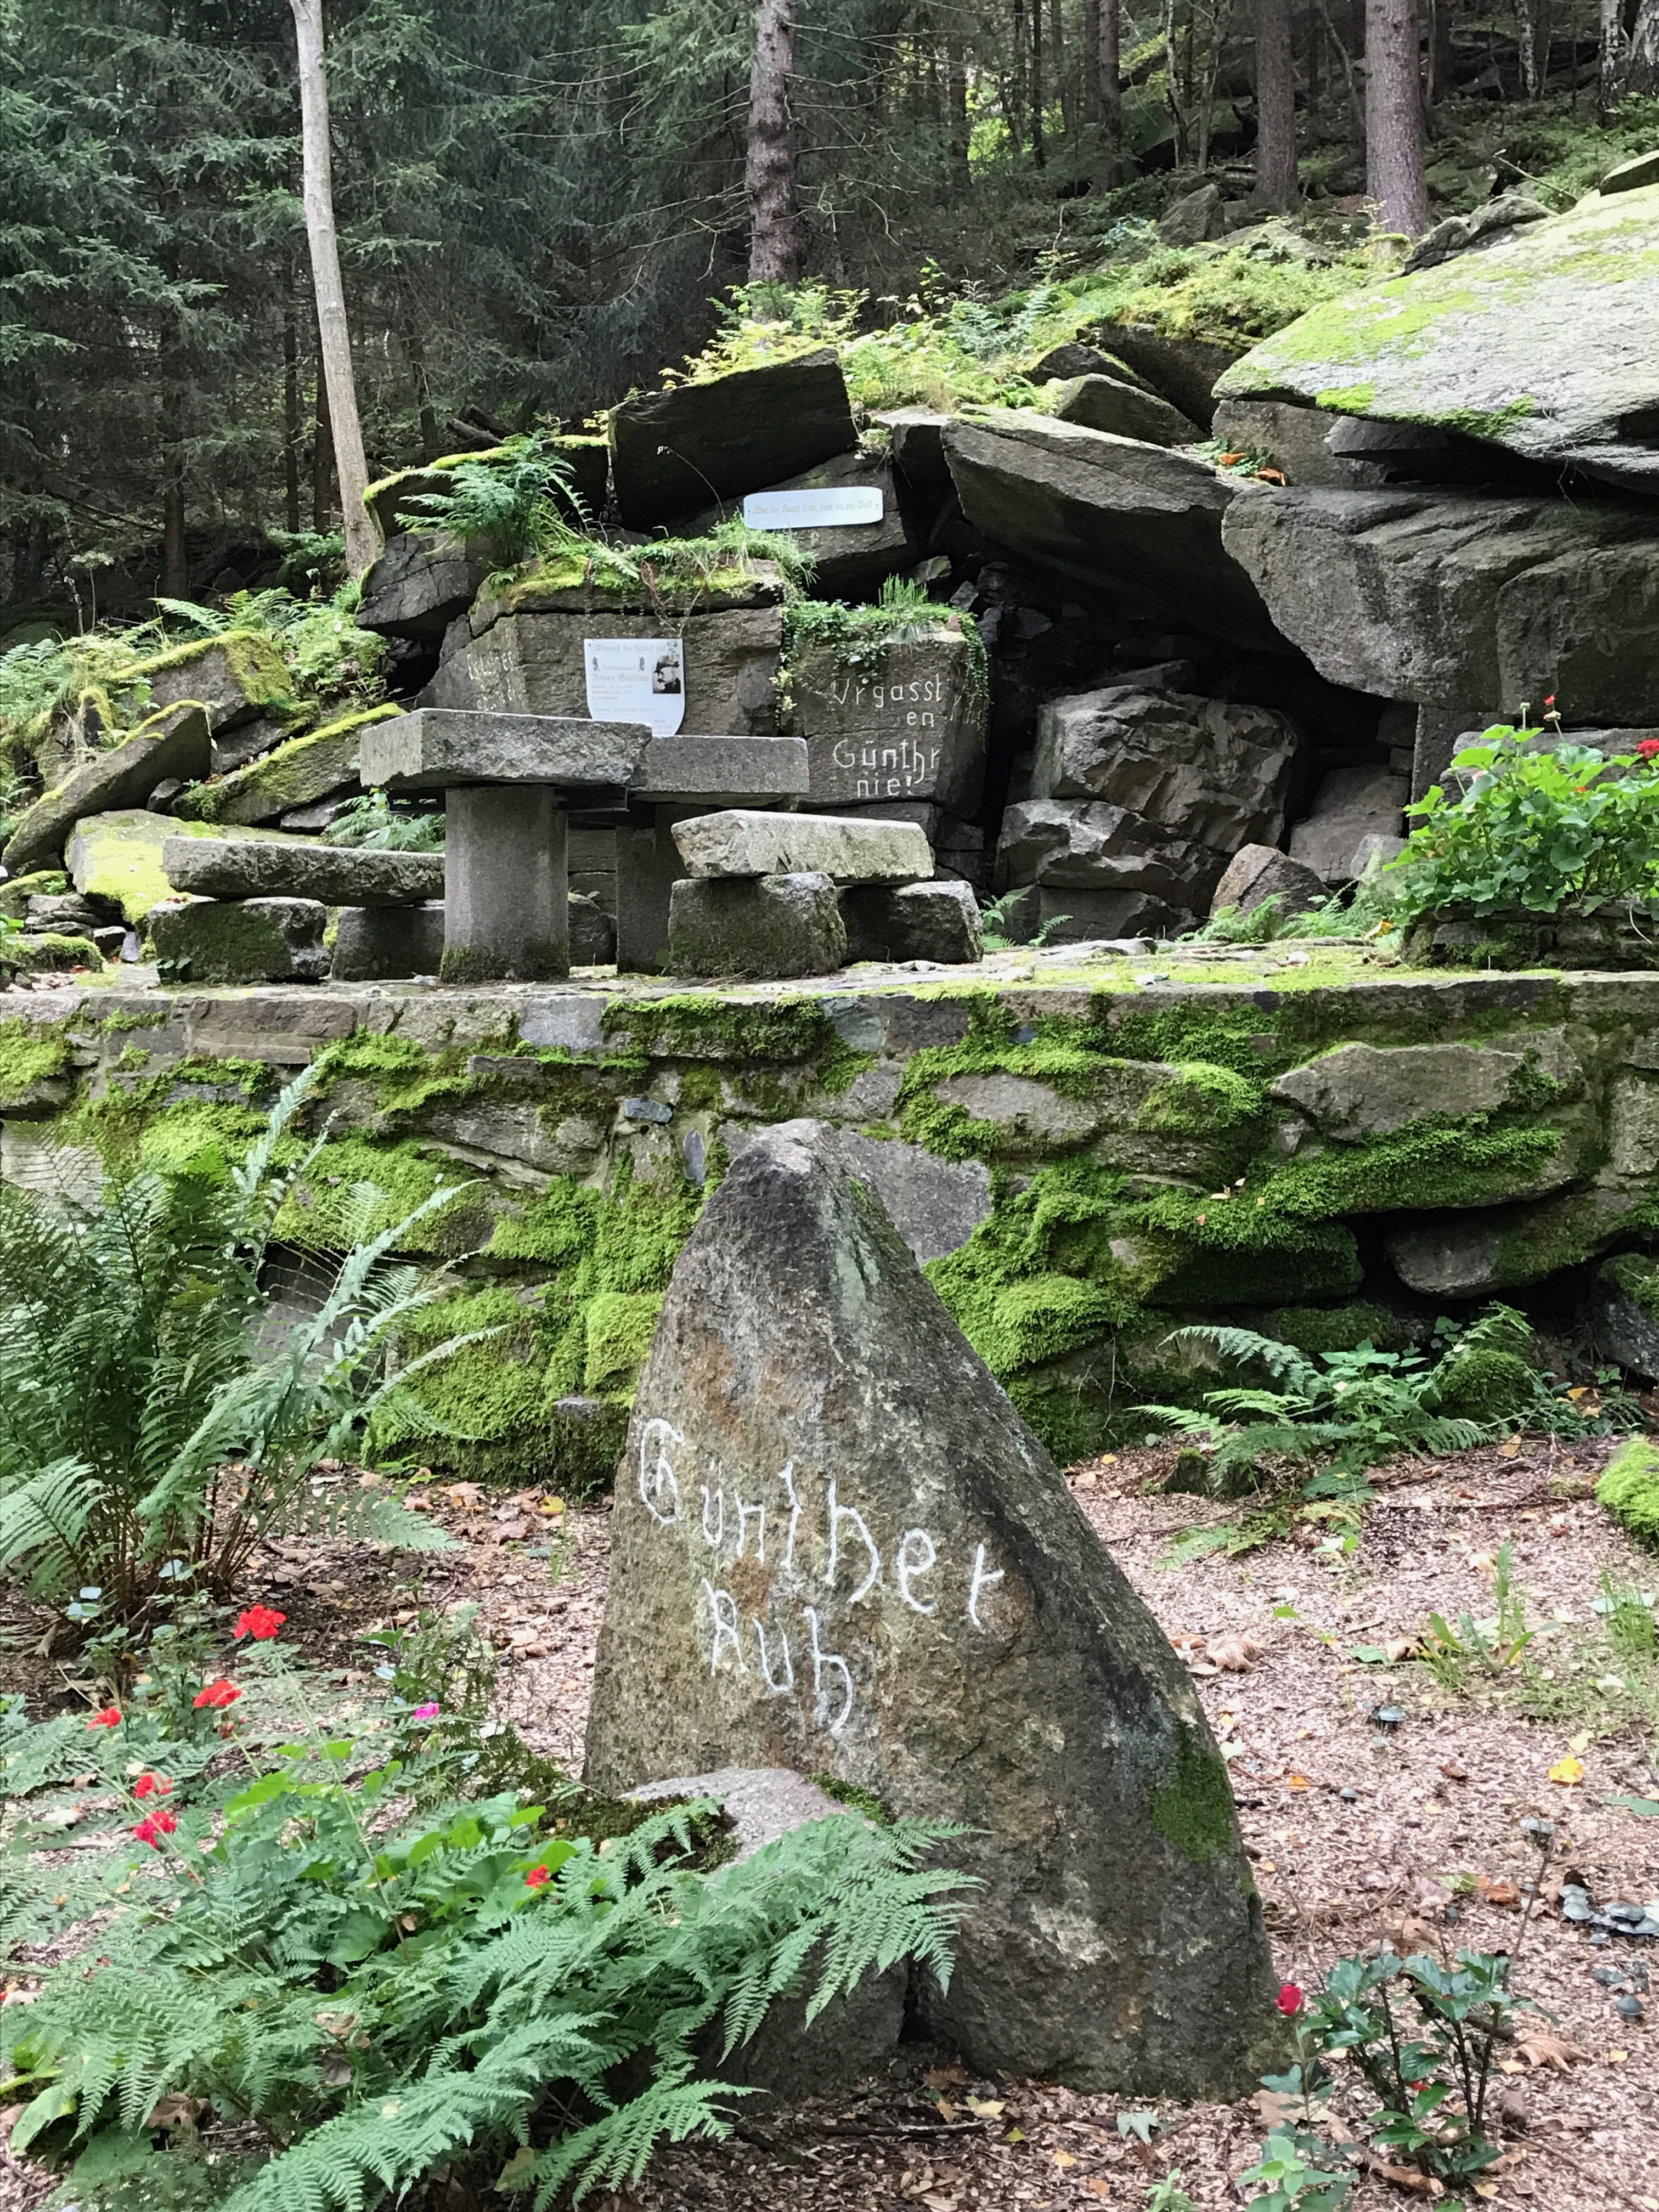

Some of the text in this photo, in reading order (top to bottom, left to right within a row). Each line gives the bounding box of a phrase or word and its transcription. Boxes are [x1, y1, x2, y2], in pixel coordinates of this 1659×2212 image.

[591, 673, 615, 682] Anton
[906, 711, 935, 727] en
[832, 738, 940, 785] Günthr
[639, 1417, 1005, 1633] Günther
[701, 1577, 854, 1733] Ruh
